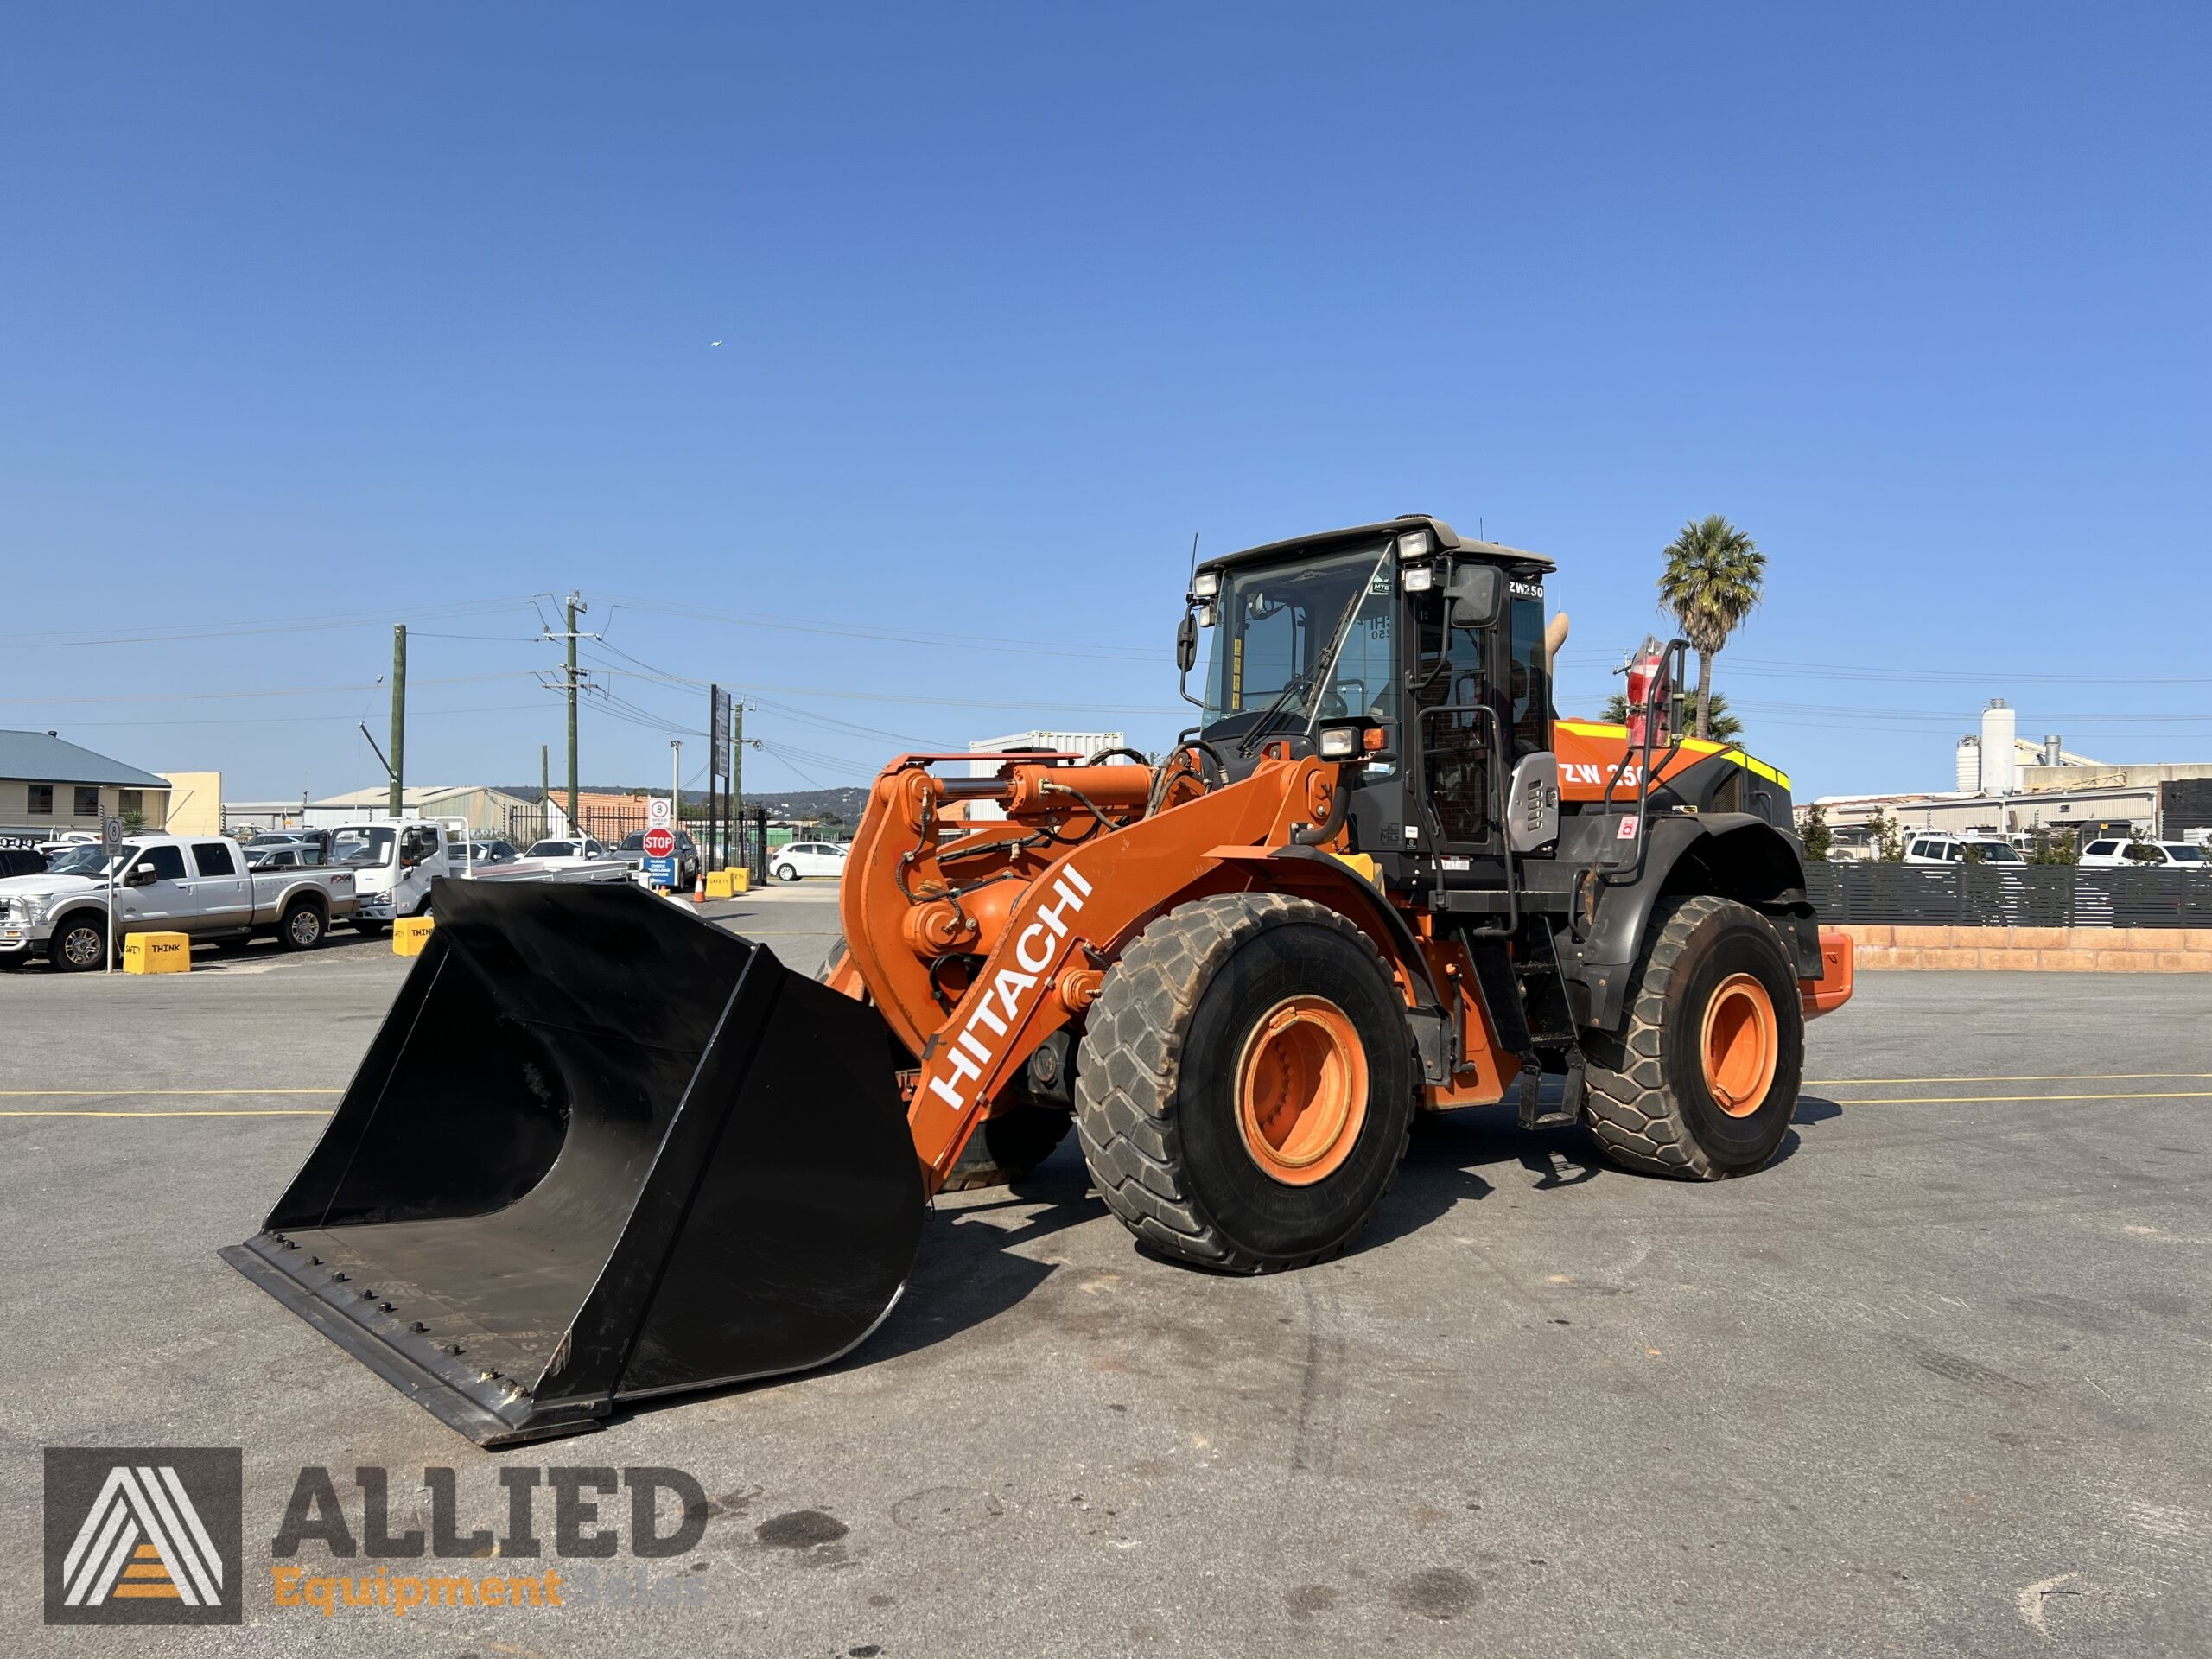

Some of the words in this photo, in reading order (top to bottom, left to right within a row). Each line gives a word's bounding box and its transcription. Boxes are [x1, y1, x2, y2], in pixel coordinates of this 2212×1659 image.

[1509, 581, 1543, 598] ZW250
[1558, 764, 1601, 785] ZW
[112, 826, 116, 836] 8
[645, 836, 672, 849] STOP
[411, 928, 432, 937] THIN
[152, 944, 181, 953] THINK
[928, 862, 1093, 1111] HITACHI
